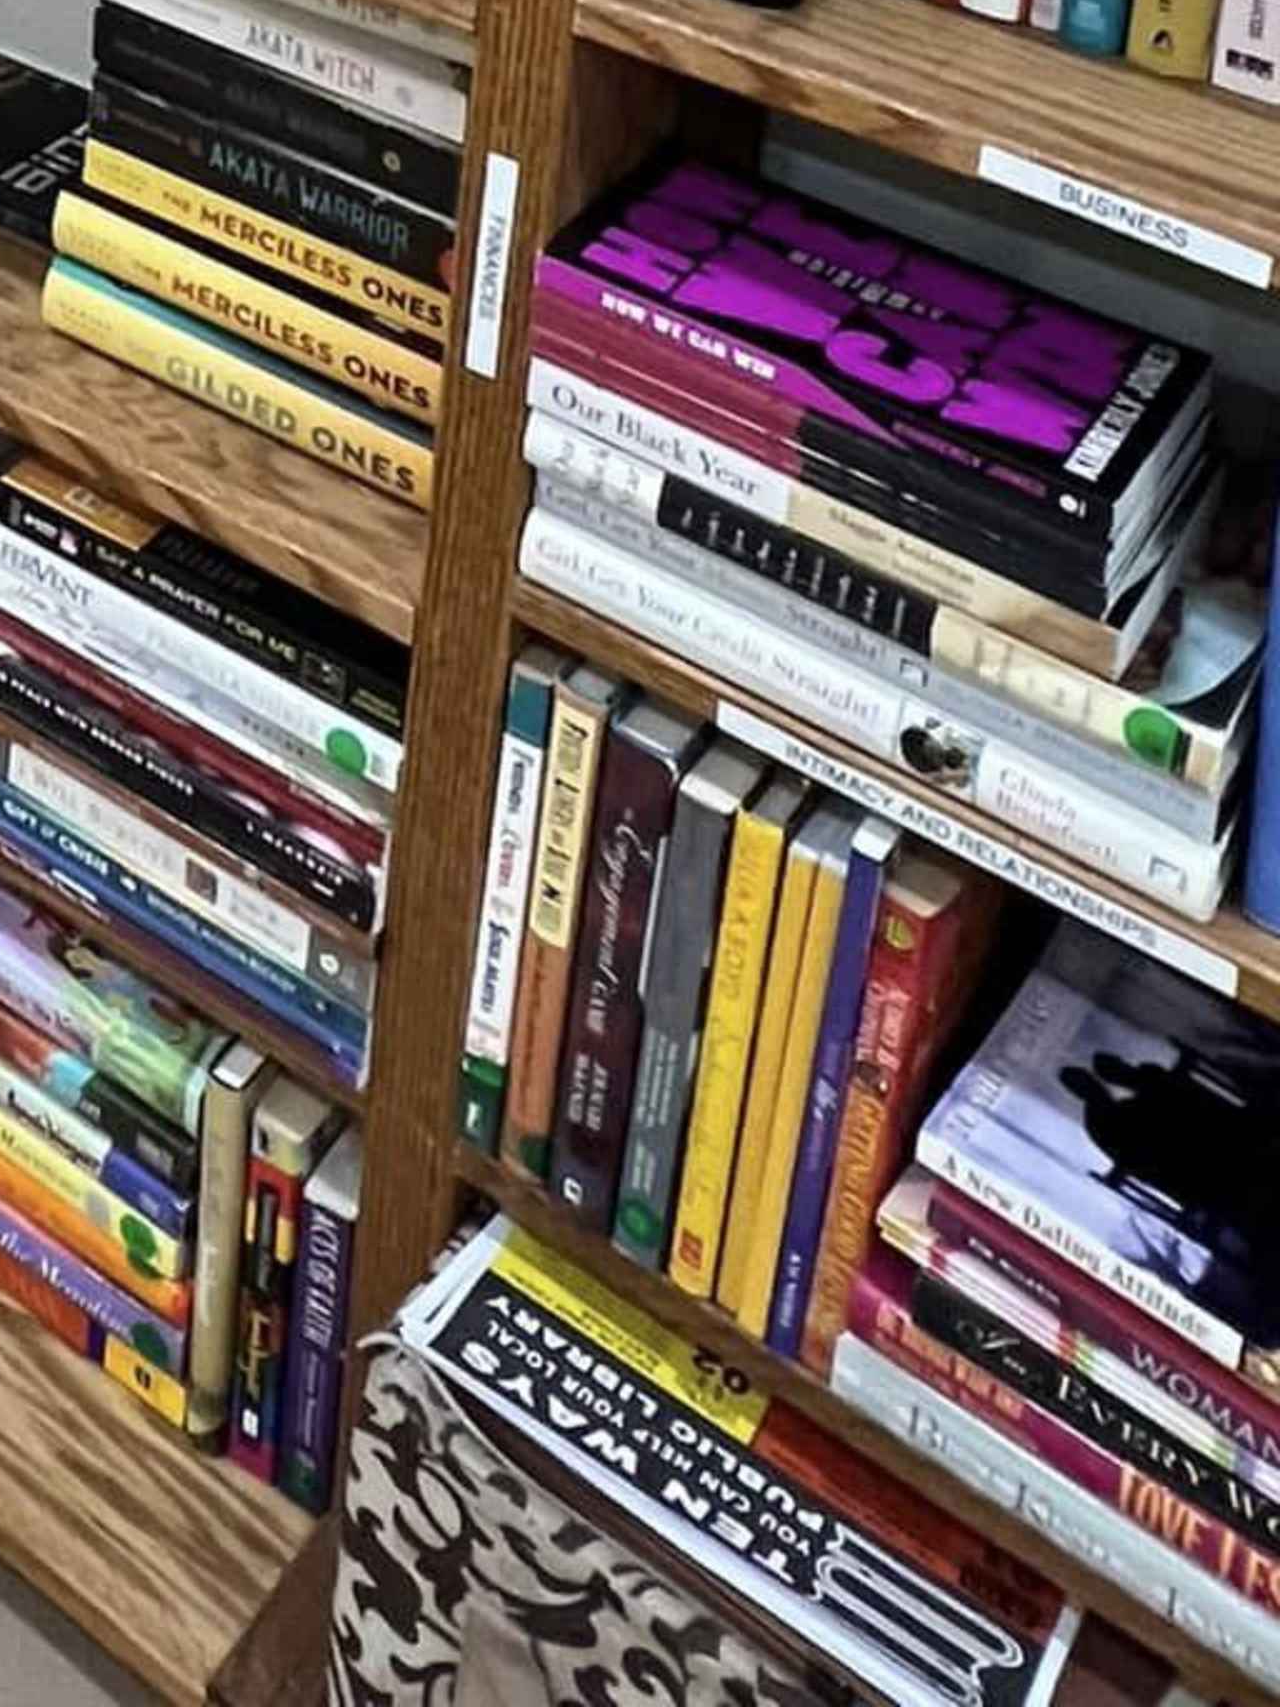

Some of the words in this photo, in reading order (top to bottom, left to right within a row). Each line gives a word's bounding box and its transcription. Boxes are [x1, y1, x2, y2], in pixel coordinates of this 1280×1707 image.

[244, 21, 306, 69] AKATA
[309, 46, 379, 95] WITCH
[205, 139, 294, 199] AKATA
[297, 177, 412, 259] WARRIOR
[1057, 181, 1191, 252] BUSINESS
[197, 203, 354, 288] MERCILESS
[359, 273, 445, 329] ONES
[169, 273, 335, 367] MERCILESS
[342, 355, 432, 411] ONES
[164, 355, 298, 434] GILDED
[309, 423, 418, 495] ONES
[551, 384, 605, 419] Our
[615, 410, 688, 465] Black
[697, 449, 758, 498] Year
[147, 571, 221, 619] PRAYER
[223, 608, 265, 643] FOR
[266, 633, 299, 662] ME
[1, 799, 38, 831] GIFT
[783, 742, 896, 818] INTIMACY
[899, 801, 953, 844] AND
[955, 821, 1158, 949] RELATIONSHIPS
[942, 1153, 958, 1177] A
[962, 1163, 1014, 1213] New
[1022, 1207, 1102, 1270] Dating
[1111, 1263, 1206, 1340] Attitude
[485, 1318, 558, 1379] LOCAL
[485, 1292, 659, 1419] LIBRARY
[560, 1371, 628, 1428] YOUR
[459, 1340, 640, 1476] WAYS
[632, 1428, 693, 1472] HELP
[661, 1478, 797, 1585] TEN
[667, 1420, 825, 1534] PUBLIC
[697, 1466, 753, 1515] CAN
[758, 1509, 814, 1557] YOU
